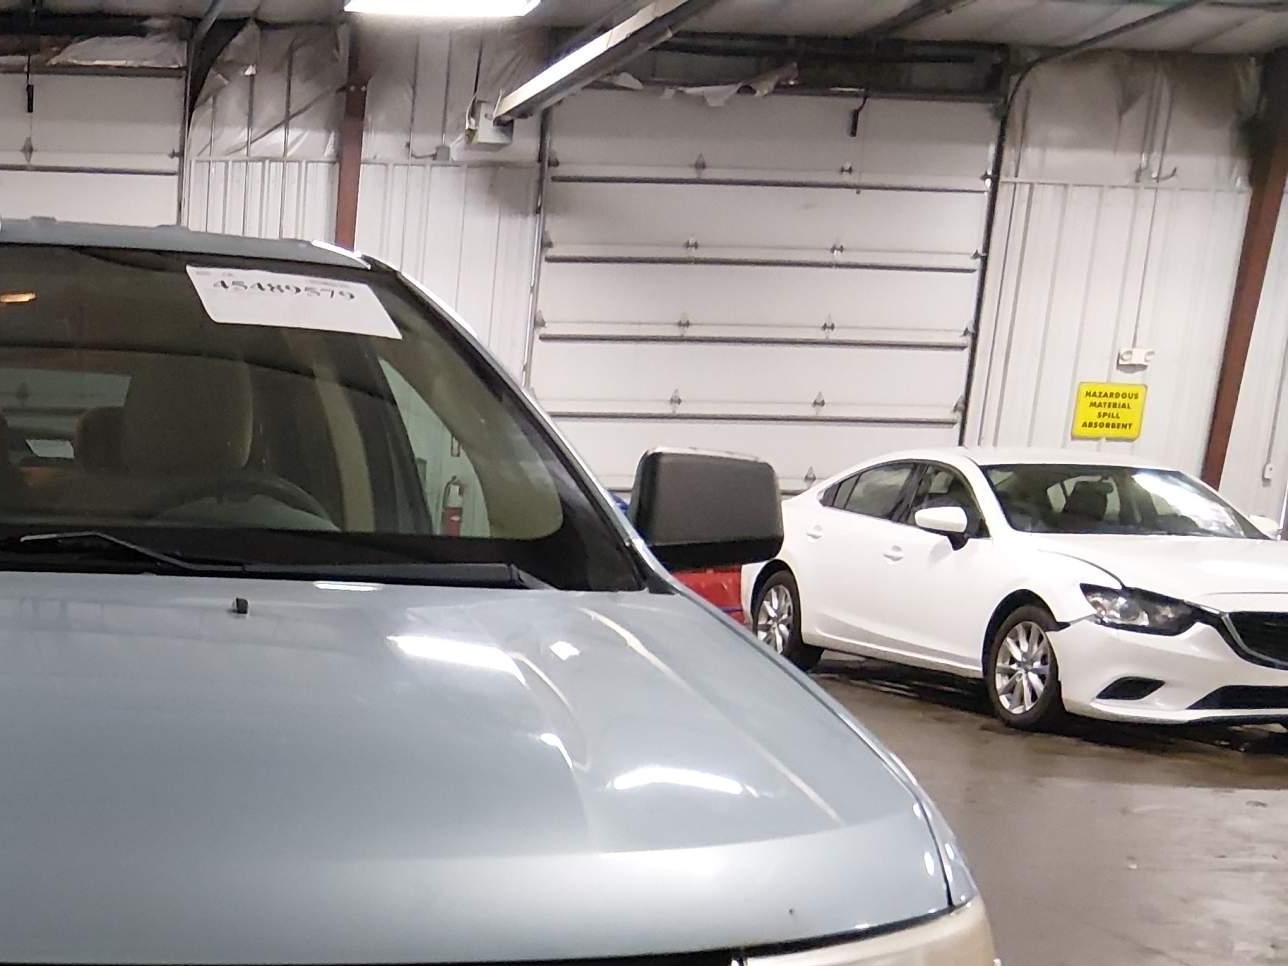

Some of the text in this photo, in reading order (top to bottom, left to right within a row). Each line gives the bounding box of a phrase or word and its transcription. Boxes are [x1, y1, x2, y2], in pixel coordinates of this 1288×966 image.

[213, 279, 355, 300] 45489579
[1085, 390, 1139, 400] HAZARDOUS
[1089, 401, 1131, 410] MATERIAL
[1097, 411, 1120, 419] SPILL
[1081, 421, 1132, 430] ABSORBENT
